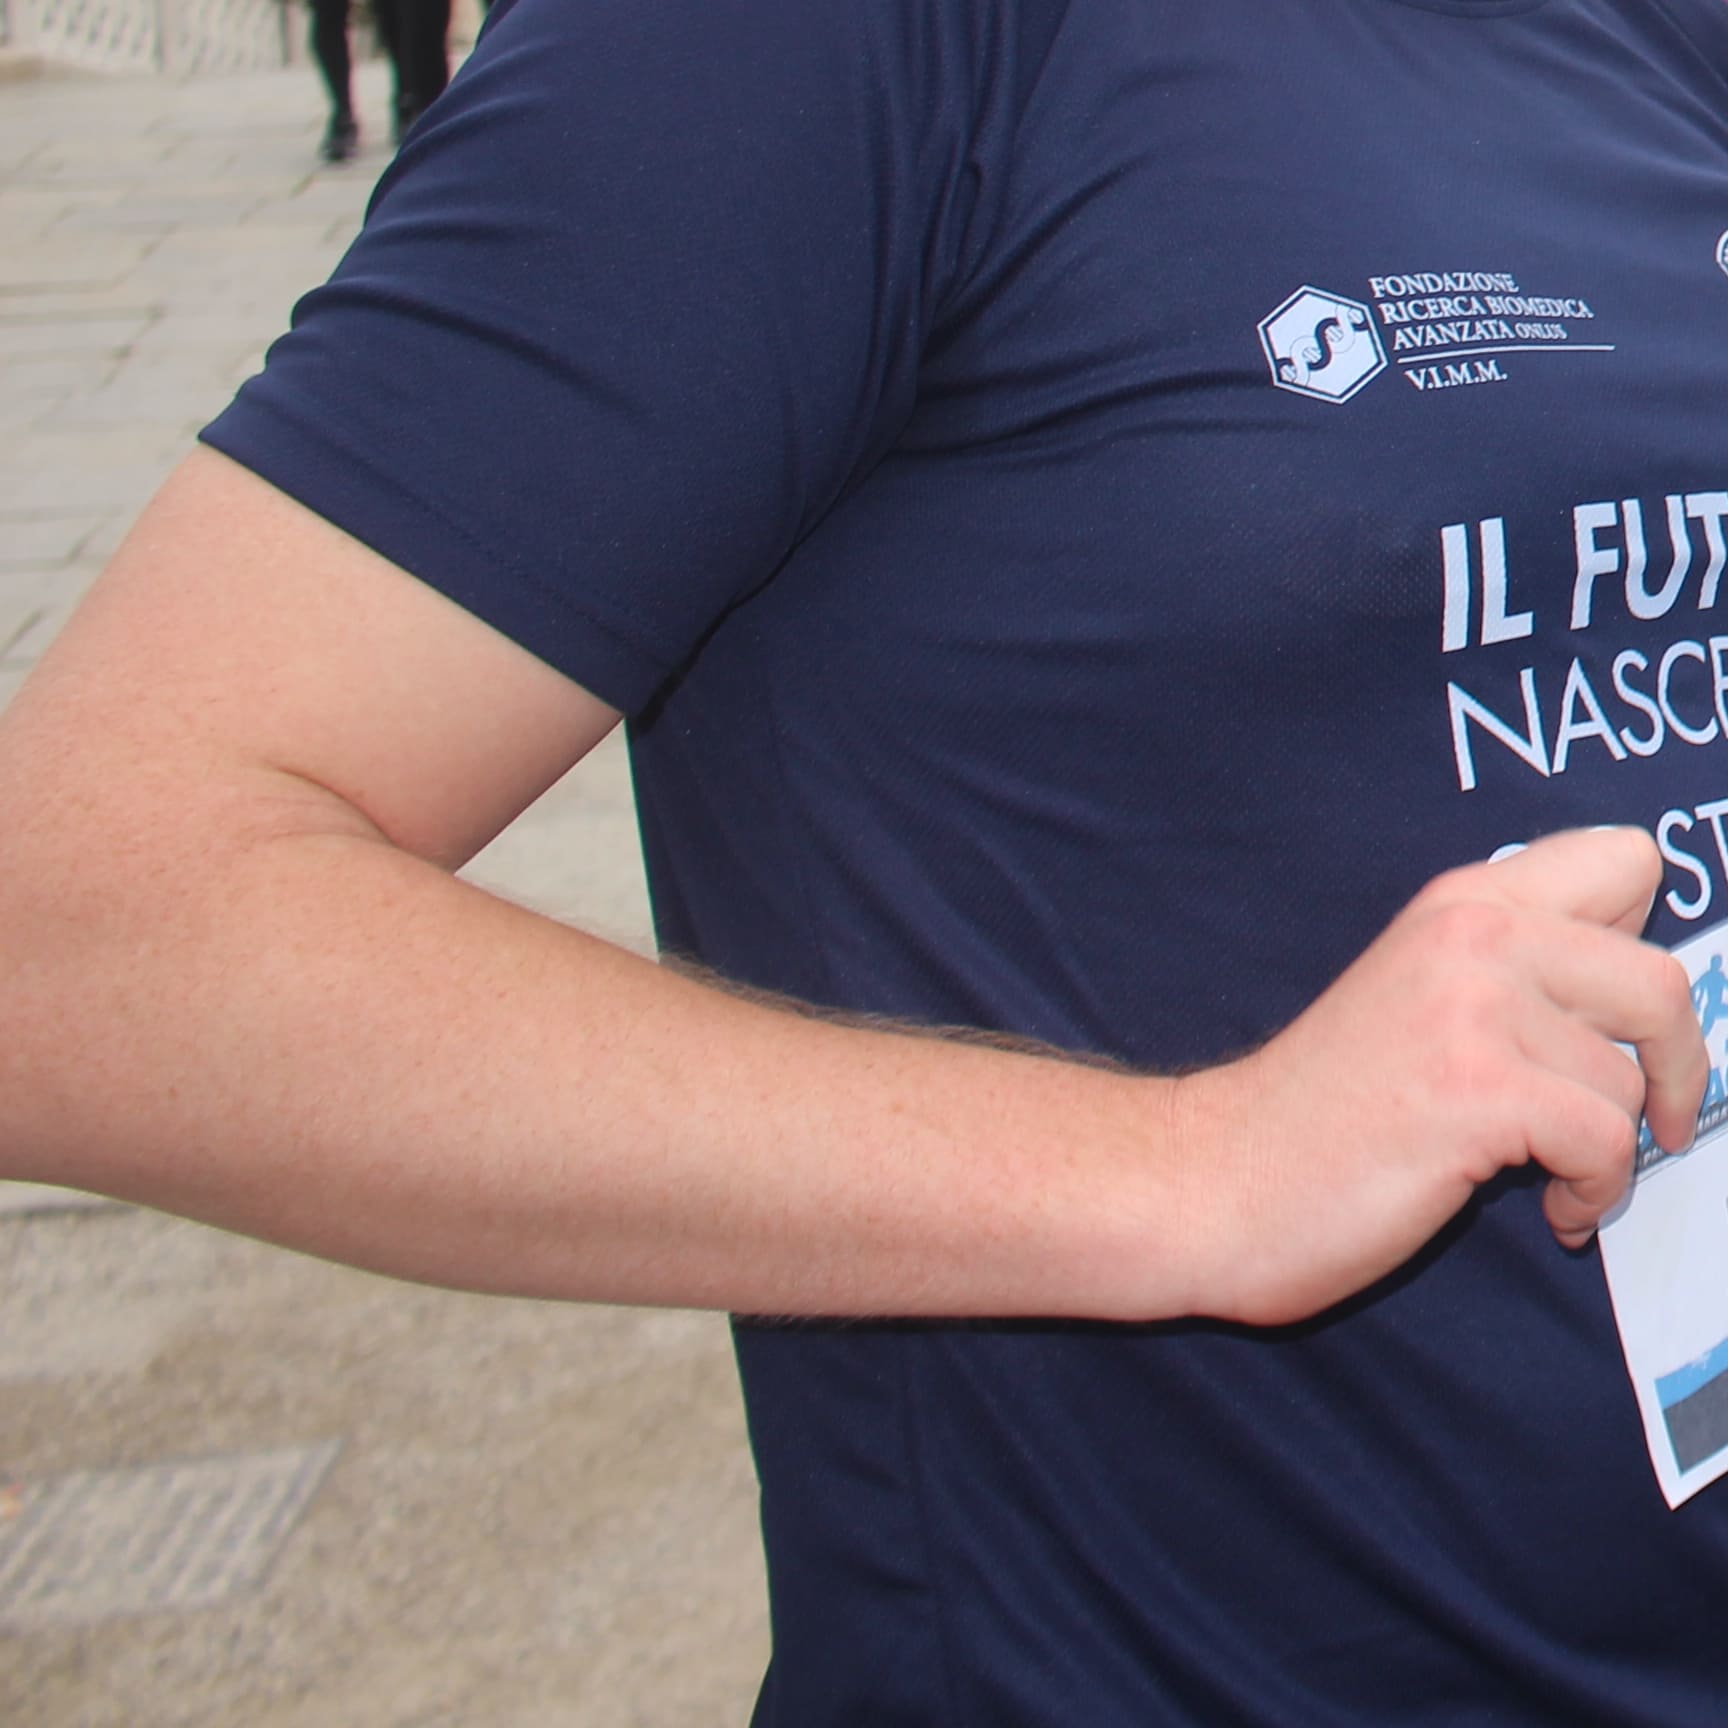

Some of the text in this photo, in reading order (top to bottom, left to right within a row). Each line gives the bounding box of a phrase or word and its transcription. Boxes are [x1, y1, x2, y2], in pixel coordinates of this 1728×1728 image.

[1368, 272, 1519, 298] FONDAZIONE
[1378, 295, 1594, 324] RICERCA BIOMEDICA
[1393, 319, 1515, 350] AVANZATA
[1404, 359, 1508, 390] V.I.M.M.
[1440, 517, 1535, 654] IL
